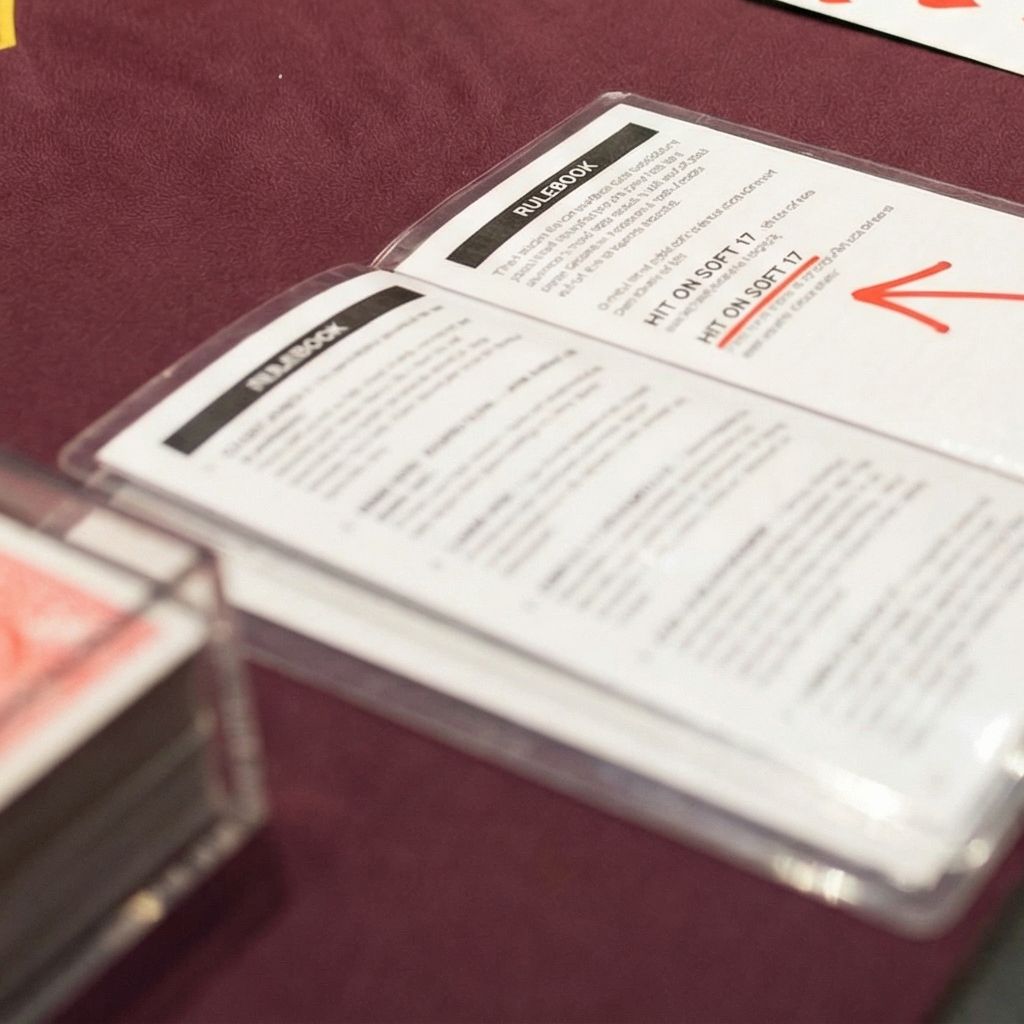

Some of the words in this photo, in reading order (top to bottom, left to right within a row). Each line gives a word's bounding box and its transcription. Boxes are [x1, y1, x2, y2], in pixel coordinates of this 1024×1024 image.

[512, 160, 599, 218] RULEBOOK
[644, 299, 676, 327] HIT
[672, 278, 702, 301] ON
[695, 244, 740, 279] SOFT
[735, 231, 757, 246] 17
[697, 319, 727, 345] HIT
[722, 297, 751, 319] ON
[744, 264, 787, 299] SOFT
[782, 250, 804, 268] 17
